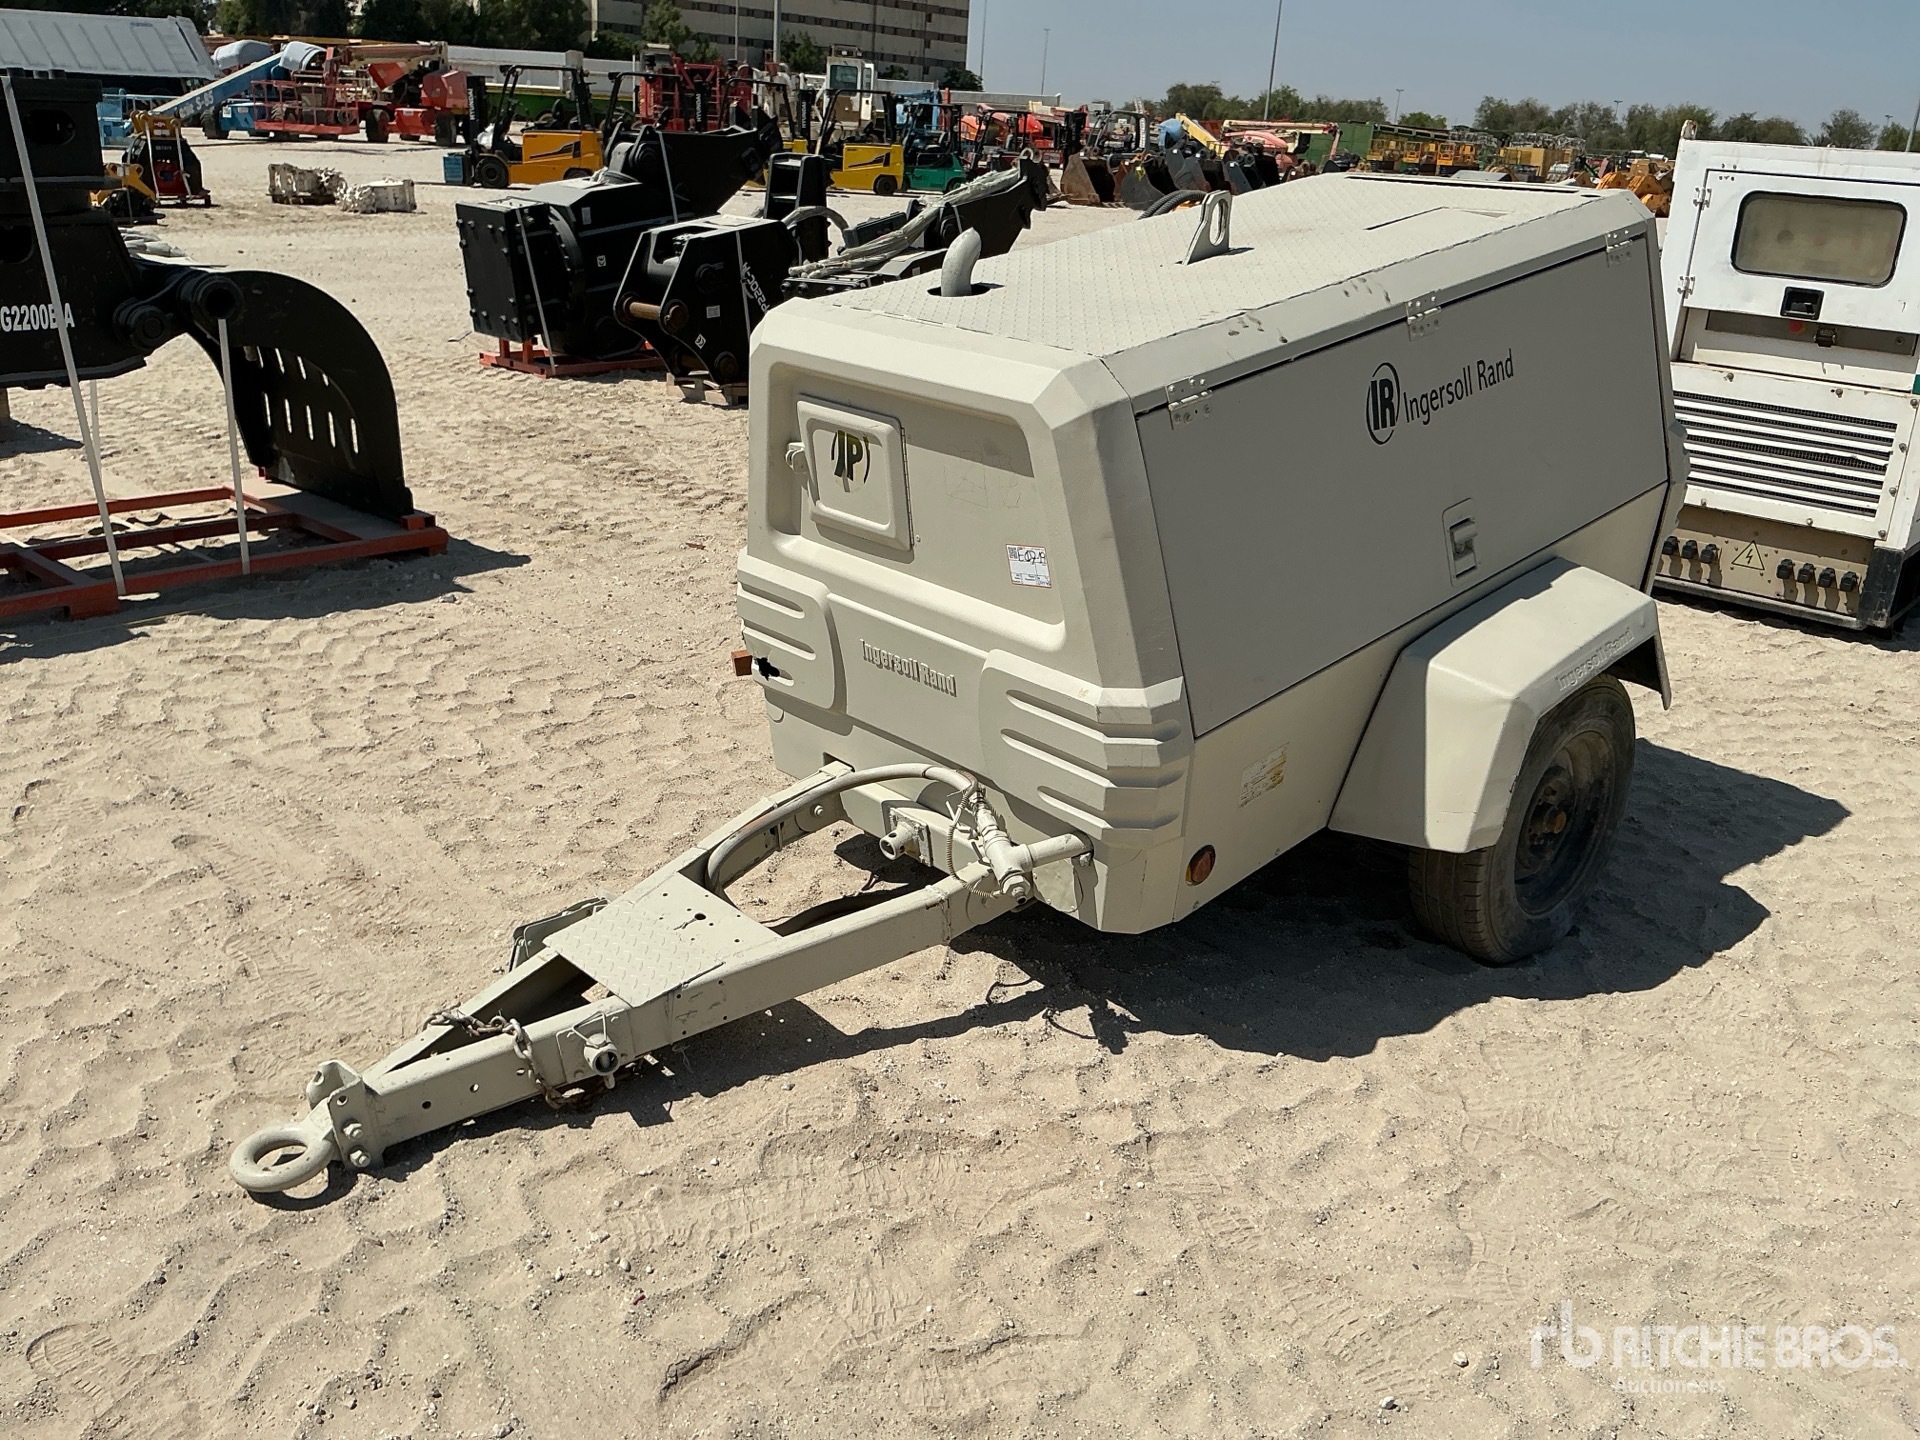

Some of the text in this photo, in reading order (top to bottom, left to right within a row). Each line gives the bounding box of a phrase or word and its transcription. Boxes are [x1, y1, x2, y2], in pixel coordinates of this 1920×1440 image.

[468, 88, 476, 120] HYUNDAI
[1370, 378, 1396, 431] IR
[1403, 348, 1514, 425] Ingersoll Rand
[860, 638, 957, 698] Ingersoll Rand
[1554, 627, 1635, 691] Ingersoll Rand
